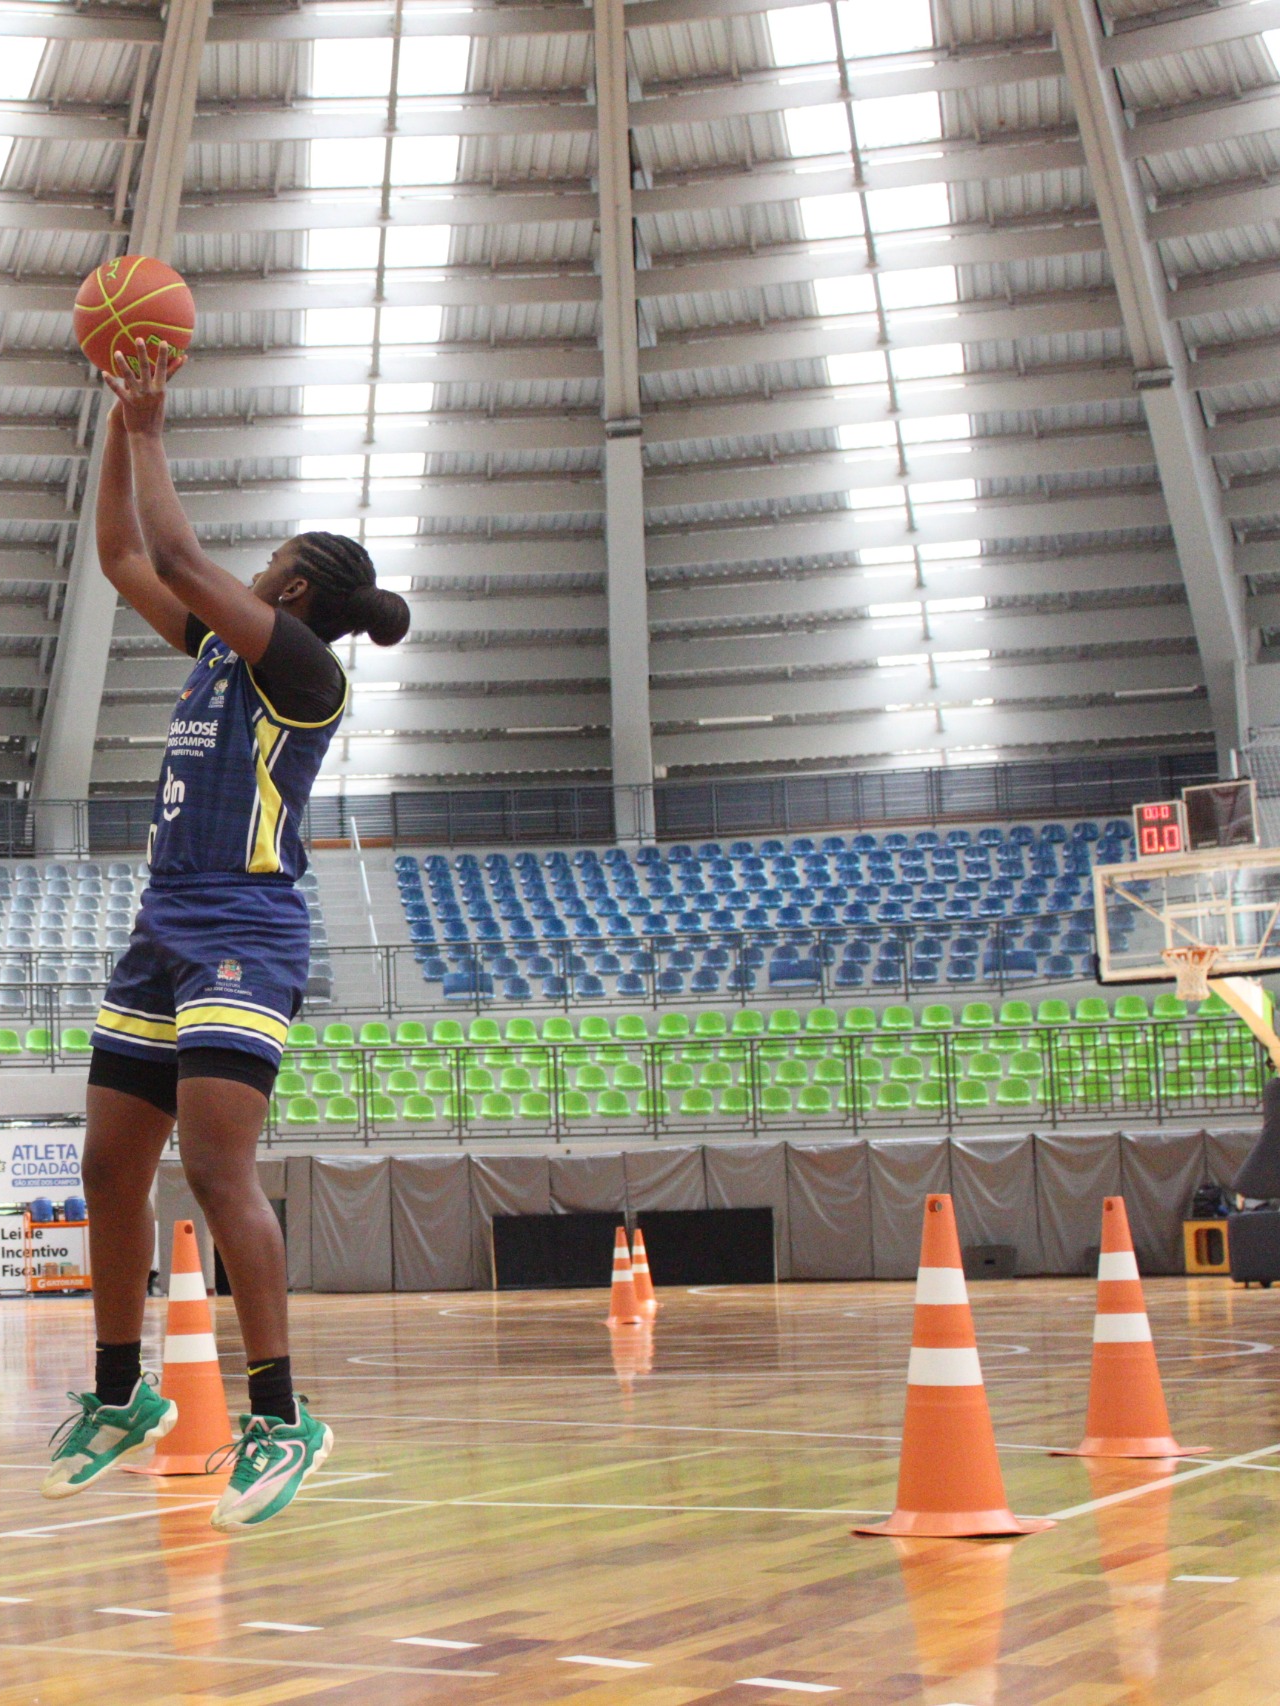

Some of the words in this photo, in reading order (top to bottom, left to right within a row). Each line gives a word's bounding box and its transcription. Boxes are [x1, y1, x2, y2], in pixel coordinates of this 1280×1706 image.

[185, 720, 218, 736] JOSÉ
[179, 736, 216, 748] CAMPOS
[12, 1144, 78, 1160] ATLETA
[11, 1161, 81, 1175] CIDADÃO
[1, 1227, 21, 1240] Lei
[1, 1245, 69, 1258] Incentivo
[2, 1264, 41, 1277] Fiscal
